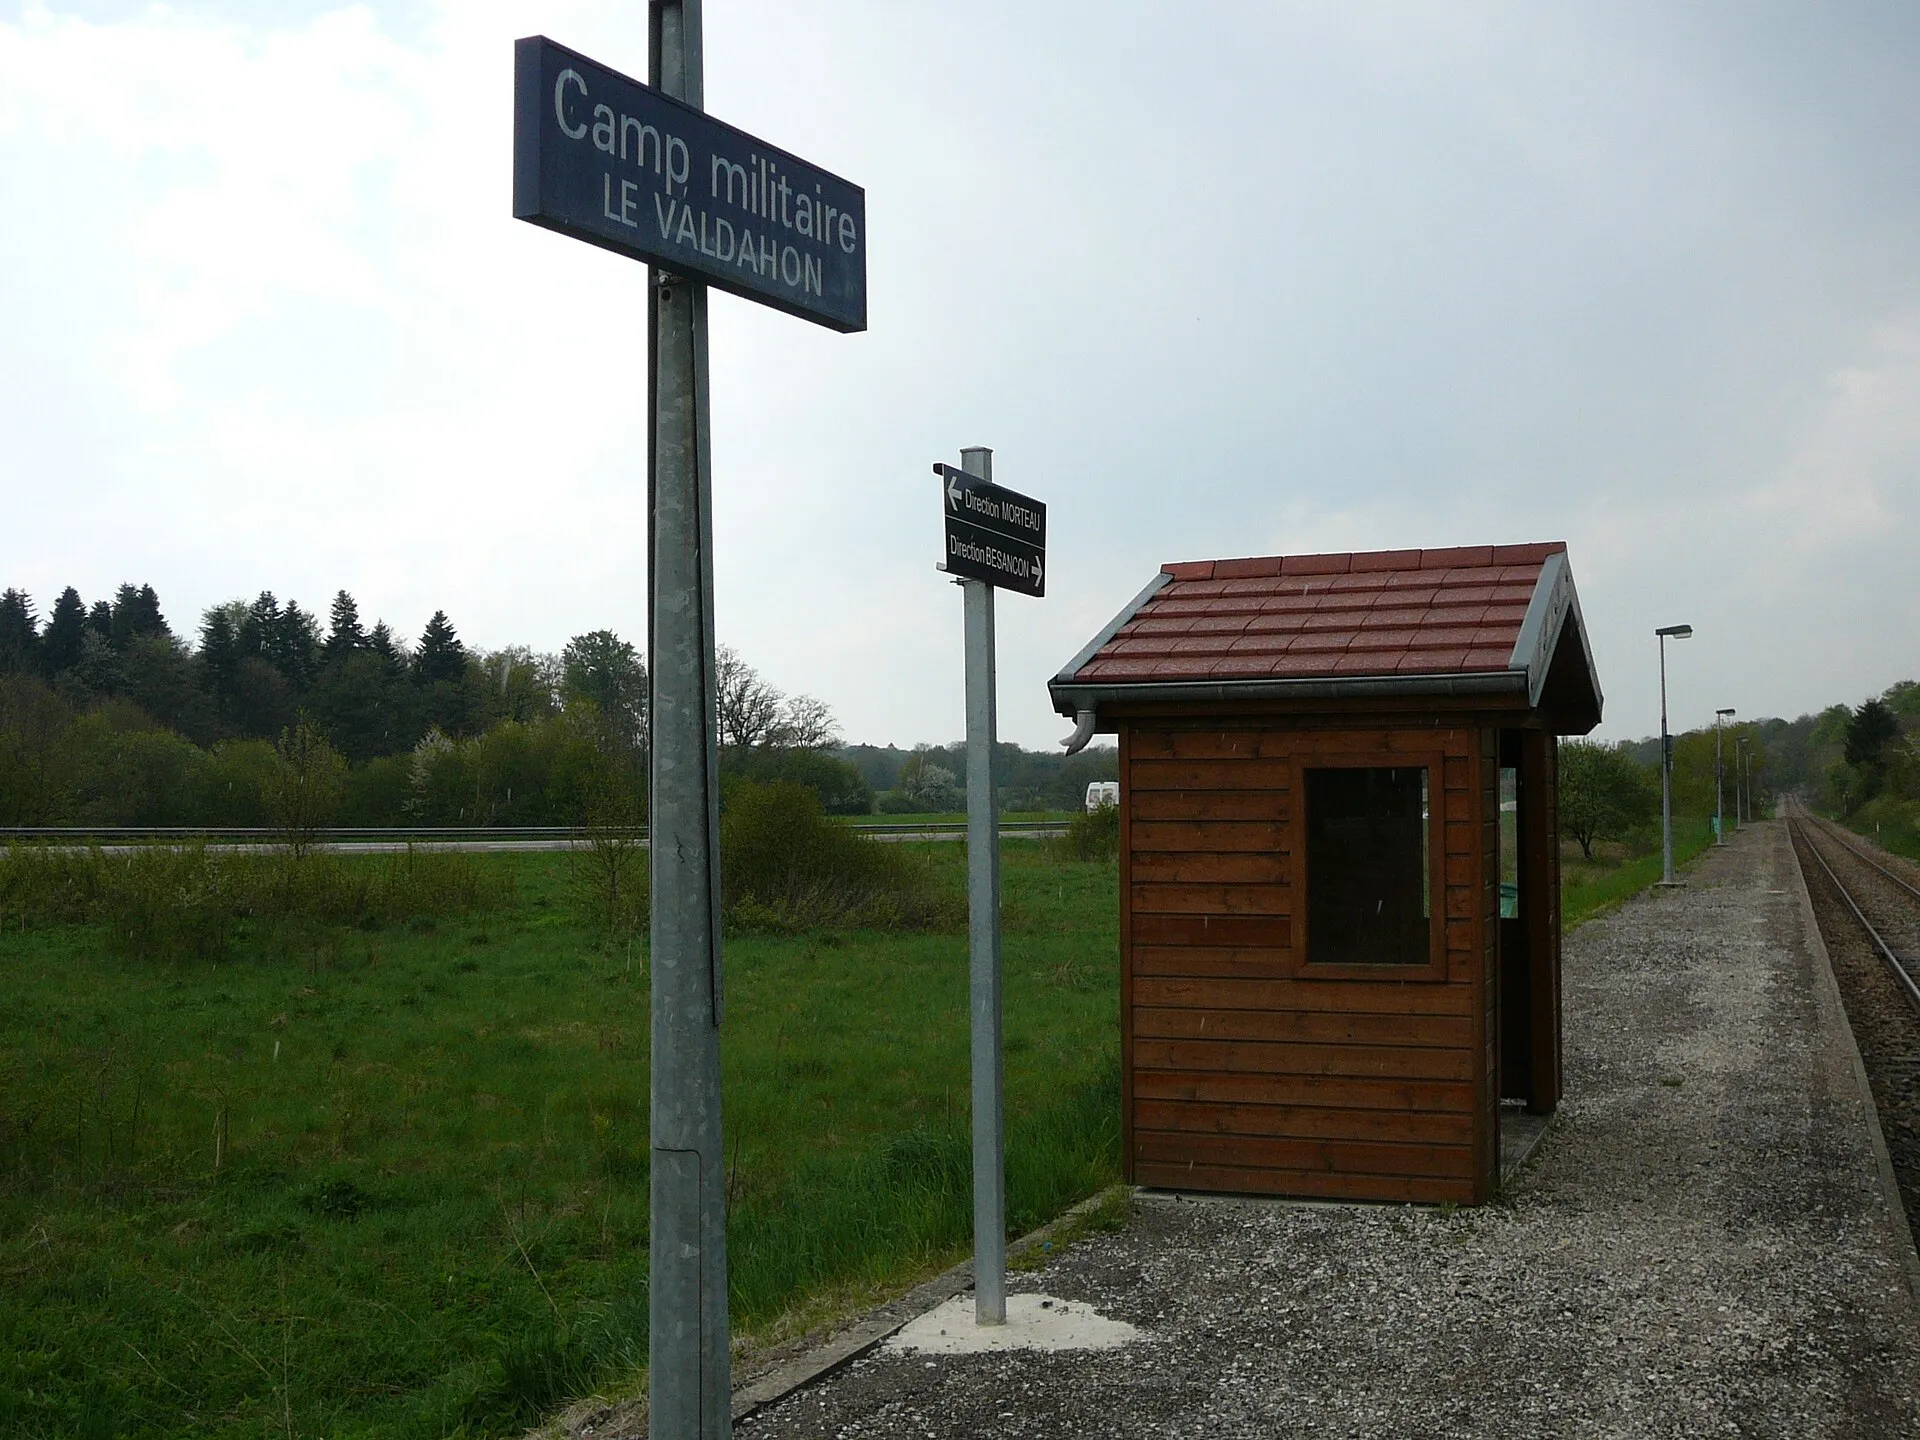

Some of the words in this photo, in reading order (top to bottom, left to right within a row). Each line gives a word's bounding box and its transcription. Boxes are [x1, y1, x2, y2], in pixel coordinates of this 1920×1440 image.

[554, 68, 690, 196] Camp
[711, 153, 857, 254] militaire
[603, 172, 638, 228] LE
[654, 192, 822, 297] VALDAHON
[950, 534, 985, 564] Direction
[965, 488, 1000, 519] Direction
[1001, 501, 1040, 532] MORTEAU
